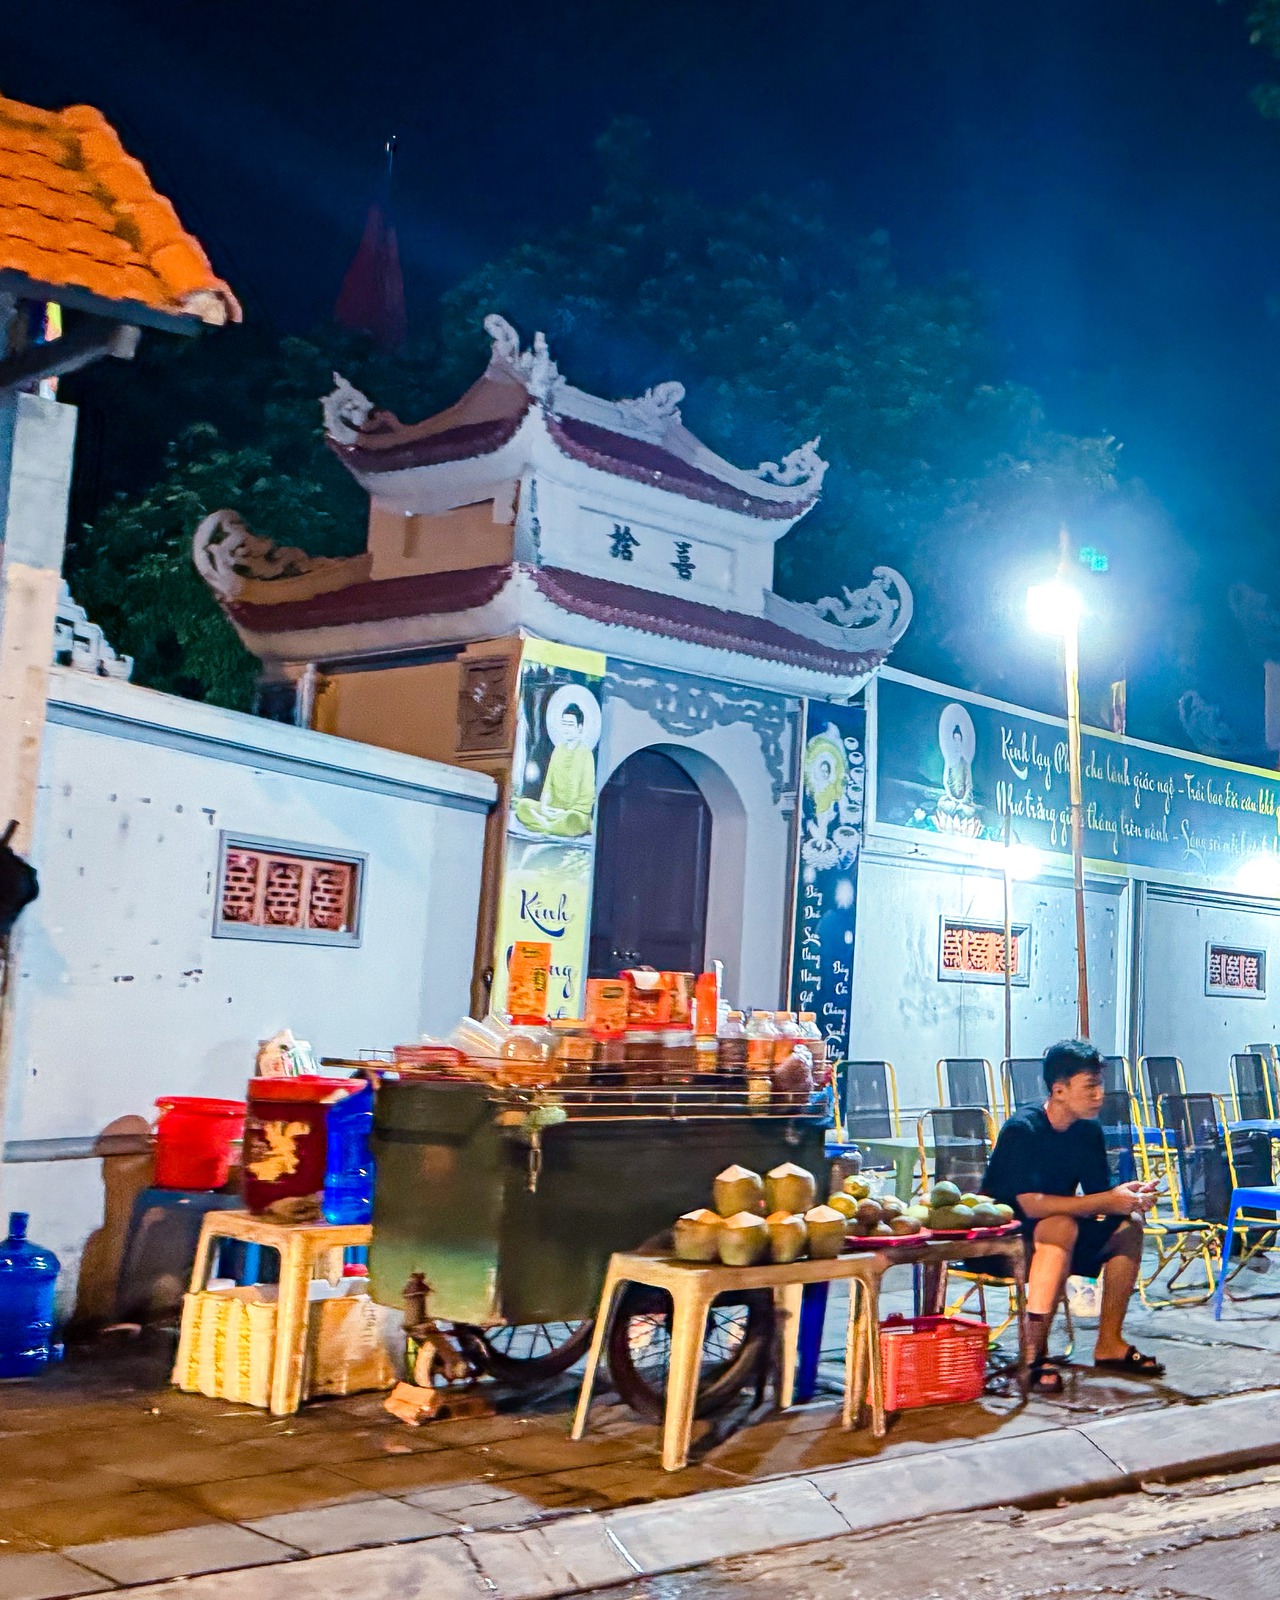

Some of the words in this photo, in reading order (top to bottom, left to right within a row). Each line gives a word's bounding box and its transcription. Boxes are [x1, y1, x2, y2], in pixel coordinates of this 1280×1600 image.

[1001, 727, 1030, 780] Kính
[1032, 735, 1051, 790] lạy
[1054, 742, 1077, 776] Ph
[1085, 750, 1104, 778] cha
[1133, 771, 1155, 809] giác
[1157, 777, 1175, 815] ngộ
[1025, 788, 1056, 846] trăng
[1086, 802, 1118, 855] tháng
[521, 889, 574, 938] Kính
